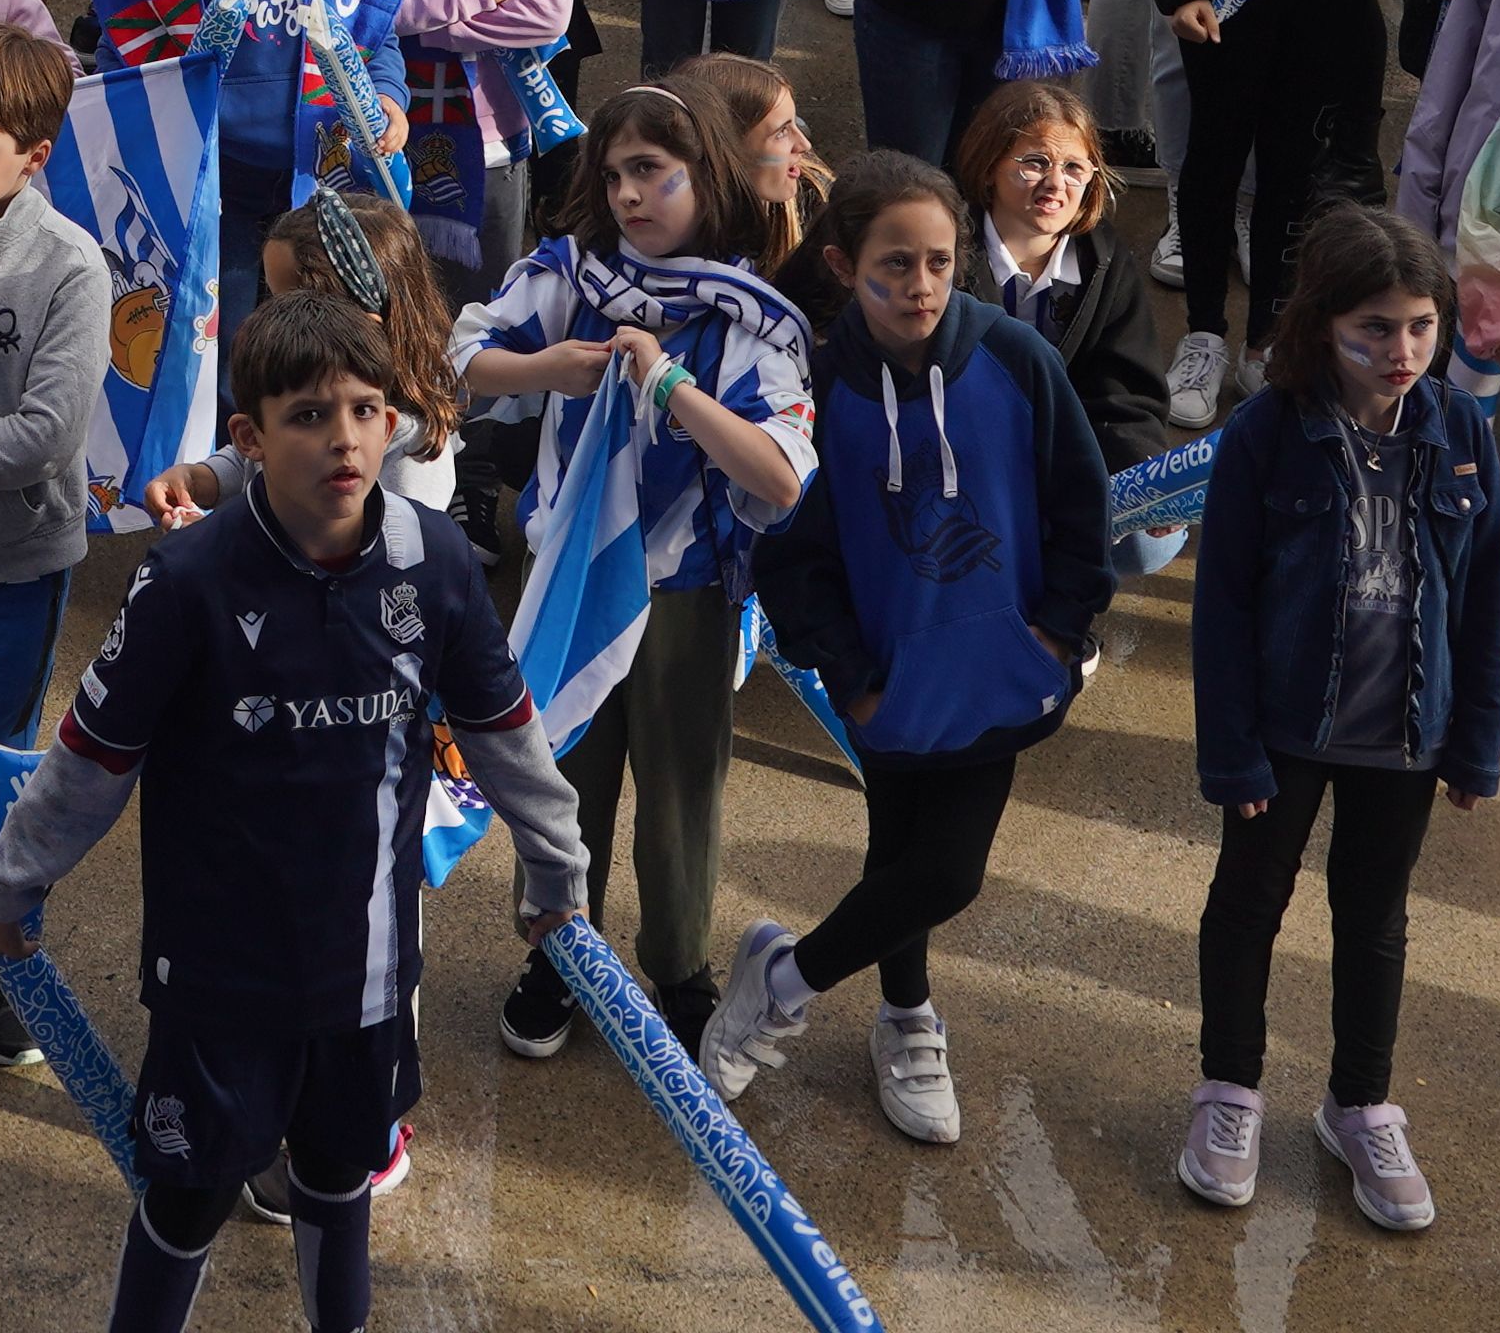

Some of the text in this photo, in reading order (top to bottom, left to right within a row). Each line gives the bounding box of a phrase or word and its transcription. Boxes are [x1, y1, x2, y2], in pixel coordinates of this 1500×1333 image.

[520, 54, 556, 108] eitb
[1169, 436, 1214, 474] eitb
[284, 687, 415, 730] YASUDA
[813, 1243, 884, 1331] eitb
